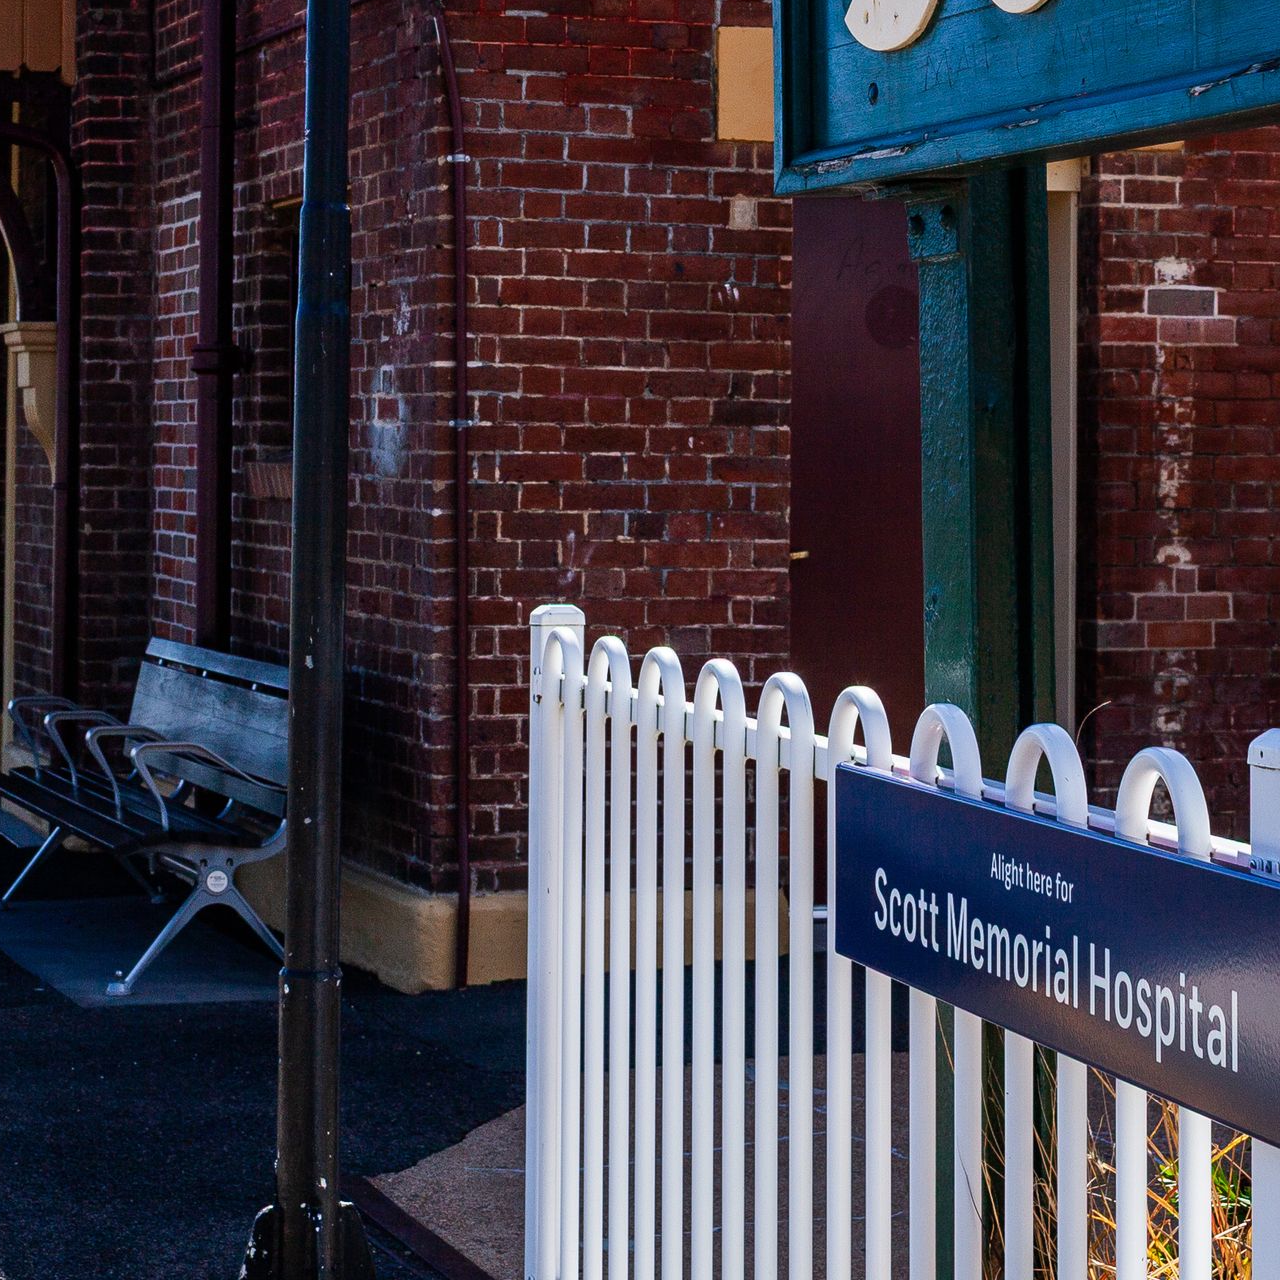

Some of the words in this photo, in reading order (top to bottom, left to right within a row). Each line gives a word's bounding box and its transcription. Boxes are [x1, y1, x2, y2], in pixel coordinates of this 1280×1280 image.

[990, 852, 1023, 890] Alight
[1026, 862, 1053, 897] here
[1055, 872, 1074, 904] for
[874, 867, 939, 953] Scott
[947, 892, 1079, 1009] Memorial
[1089, 942, 1238, 1073] Hospital
